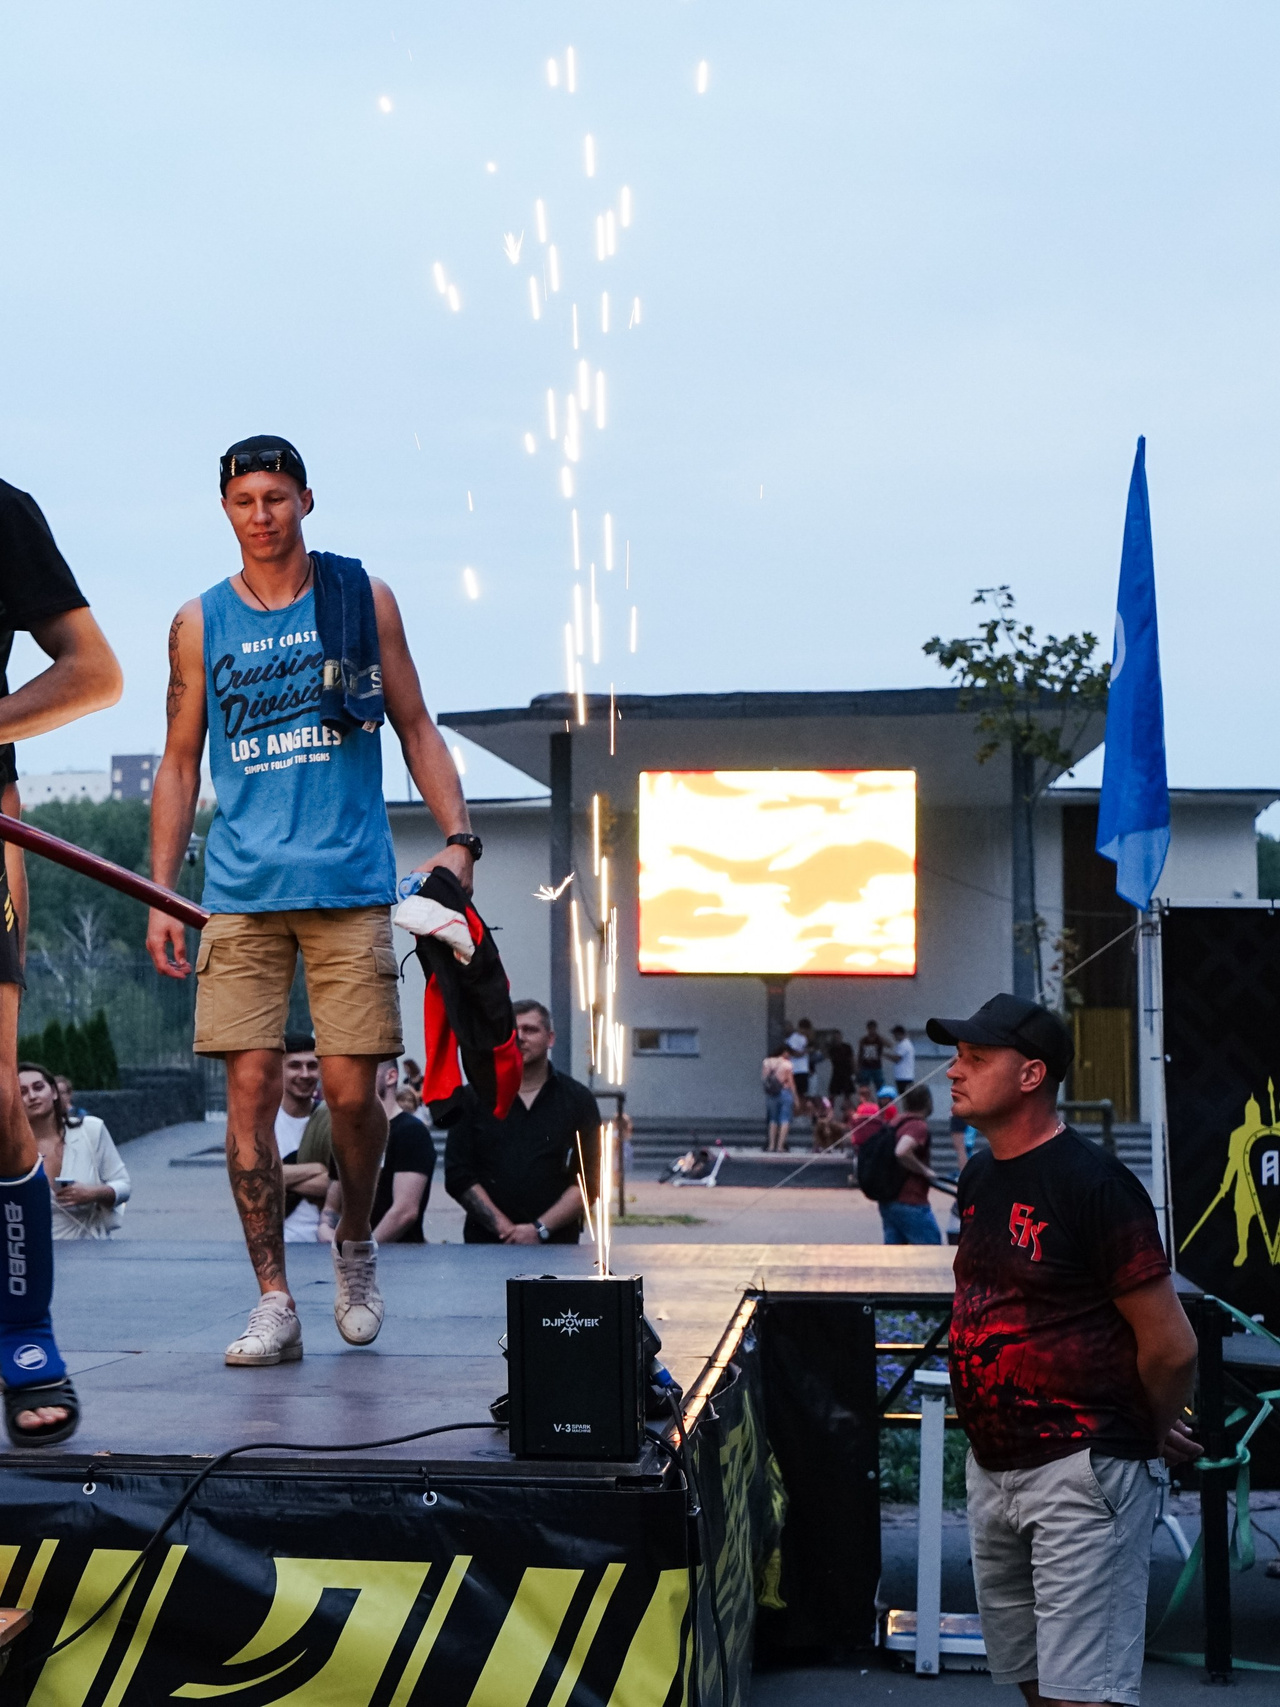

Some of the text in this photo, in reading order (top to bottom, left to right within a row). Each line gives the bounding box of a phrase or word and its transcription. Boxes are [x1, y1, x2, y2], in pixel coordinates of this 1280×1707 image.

[241, 630, 318, 654] WEST COAST
[213, 649, 324, 697] Cruisin
[231, 725, 343, 762] LOS ANGELES
[244, 762, 270, 775] SIMPLY
[294, 753, 308, 764] THE
[308, 752, 331, 763] SIGNS
[553, 1423, 572, 1433] V-3
